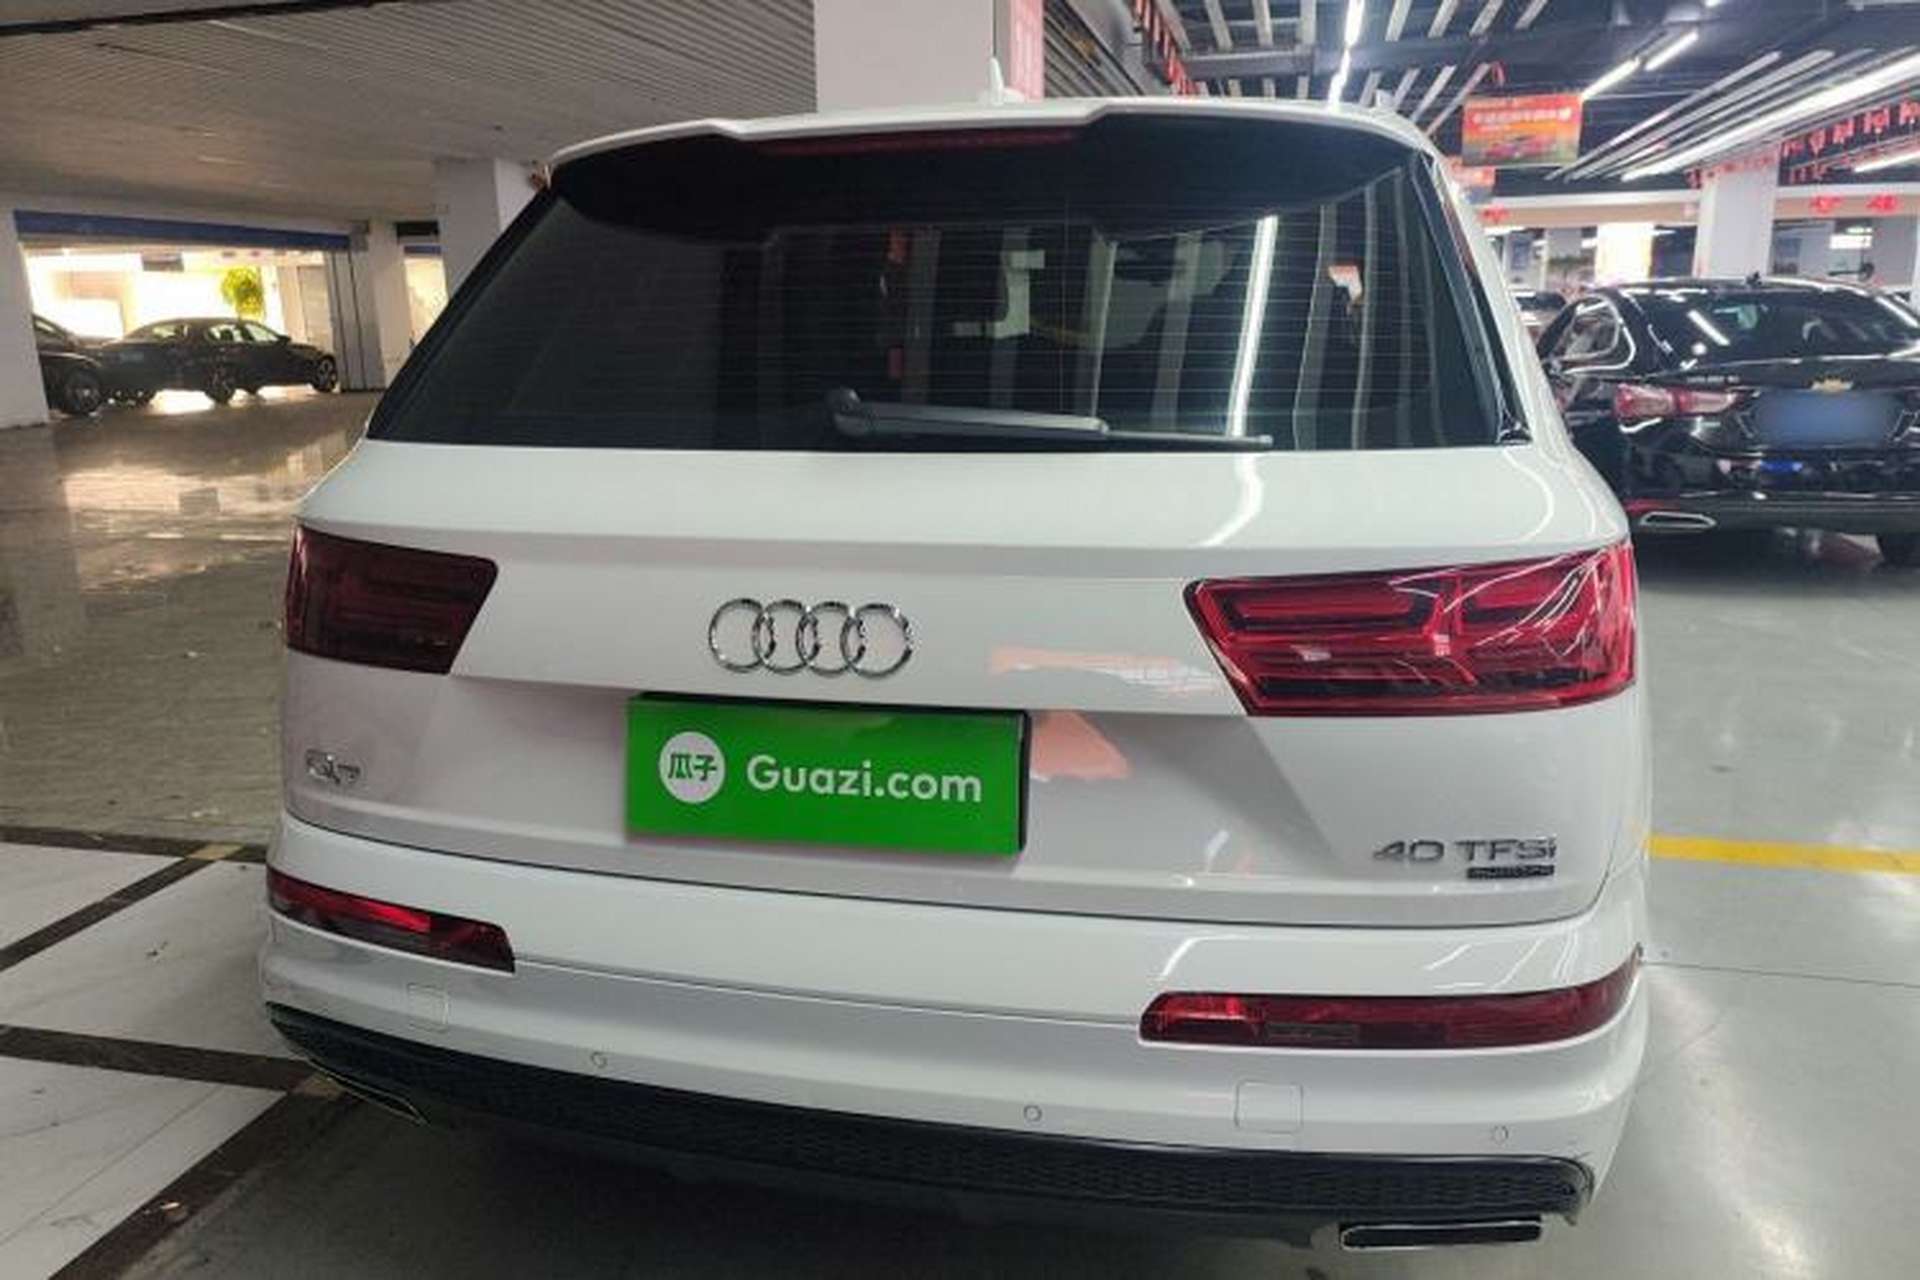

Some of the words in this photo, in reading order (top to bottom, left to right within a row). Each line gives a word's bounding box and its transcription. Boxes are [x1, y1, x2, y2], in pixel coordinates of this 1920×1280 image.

[668, 753, 717, 781] 瓜子
[745, 754, 981, 803] Guazi.com
[1372, 840, 1446, 862] 40
